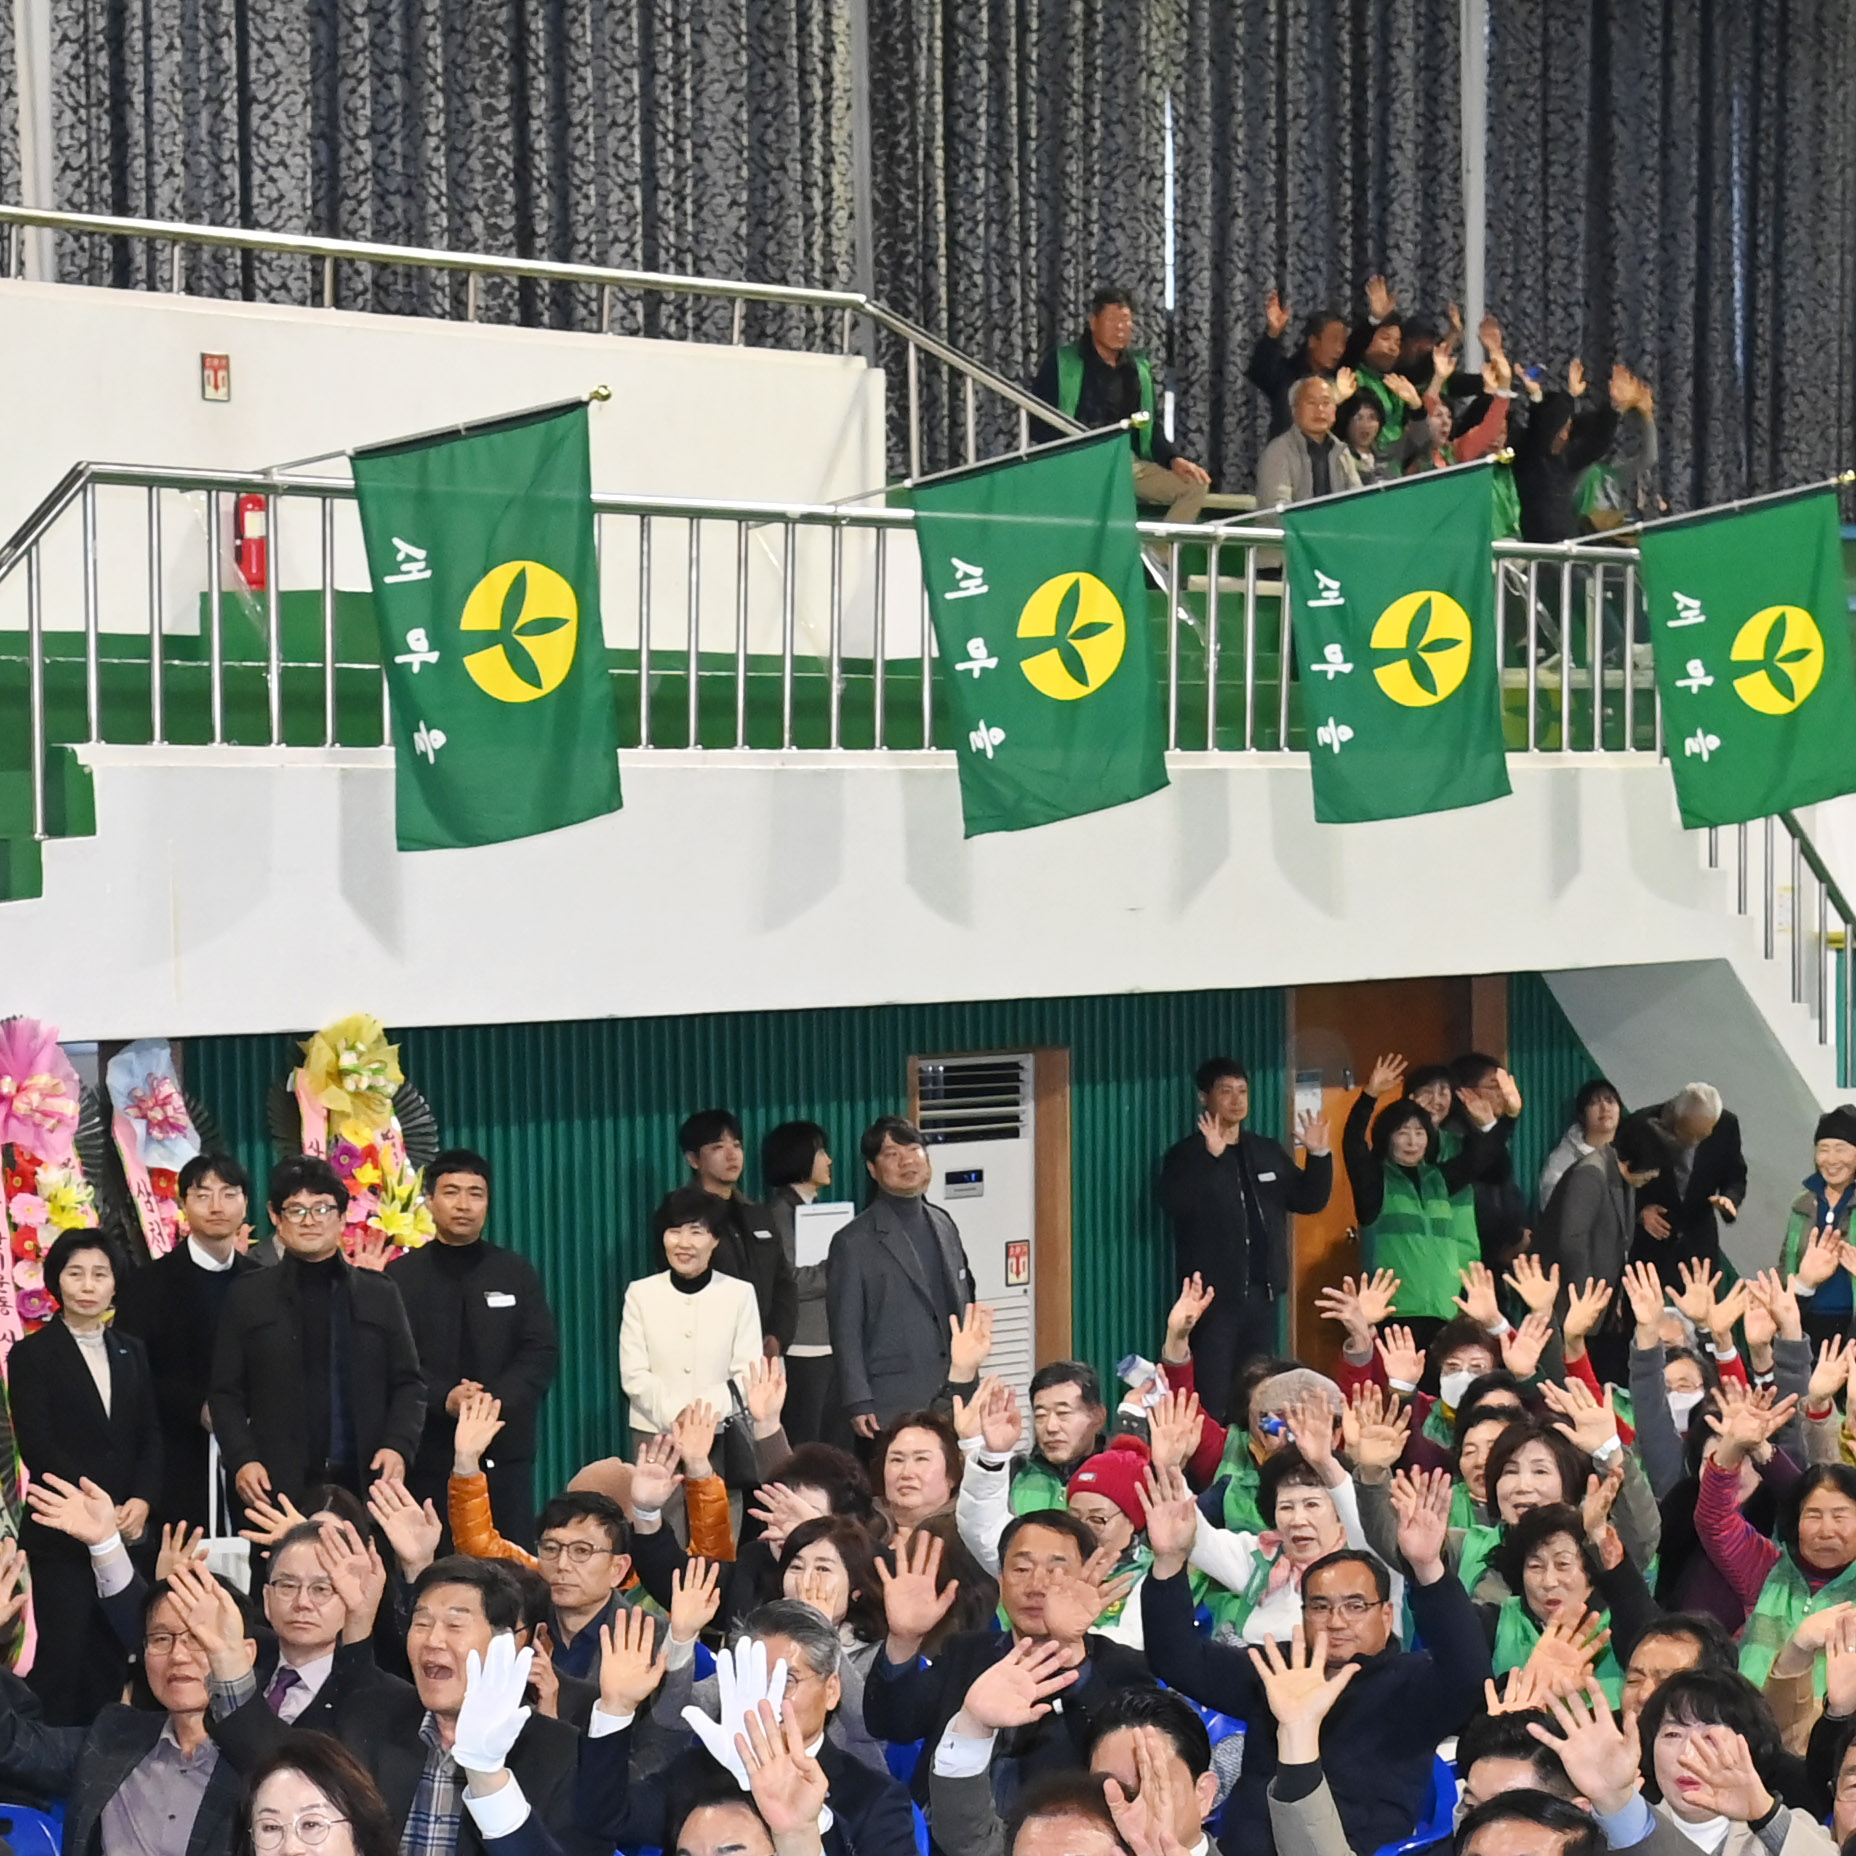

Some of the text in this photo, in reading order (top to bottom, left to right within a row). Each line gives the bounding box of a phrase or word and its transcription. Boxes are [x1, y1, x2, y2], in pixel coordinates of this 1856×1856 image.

[384, 536, 447, 764] 새마을
[945, 556, 1006, 758] 새마을
[1307, 568, 1354, 754] 새마을
[1666, 592, 1721, 762] 새마을
